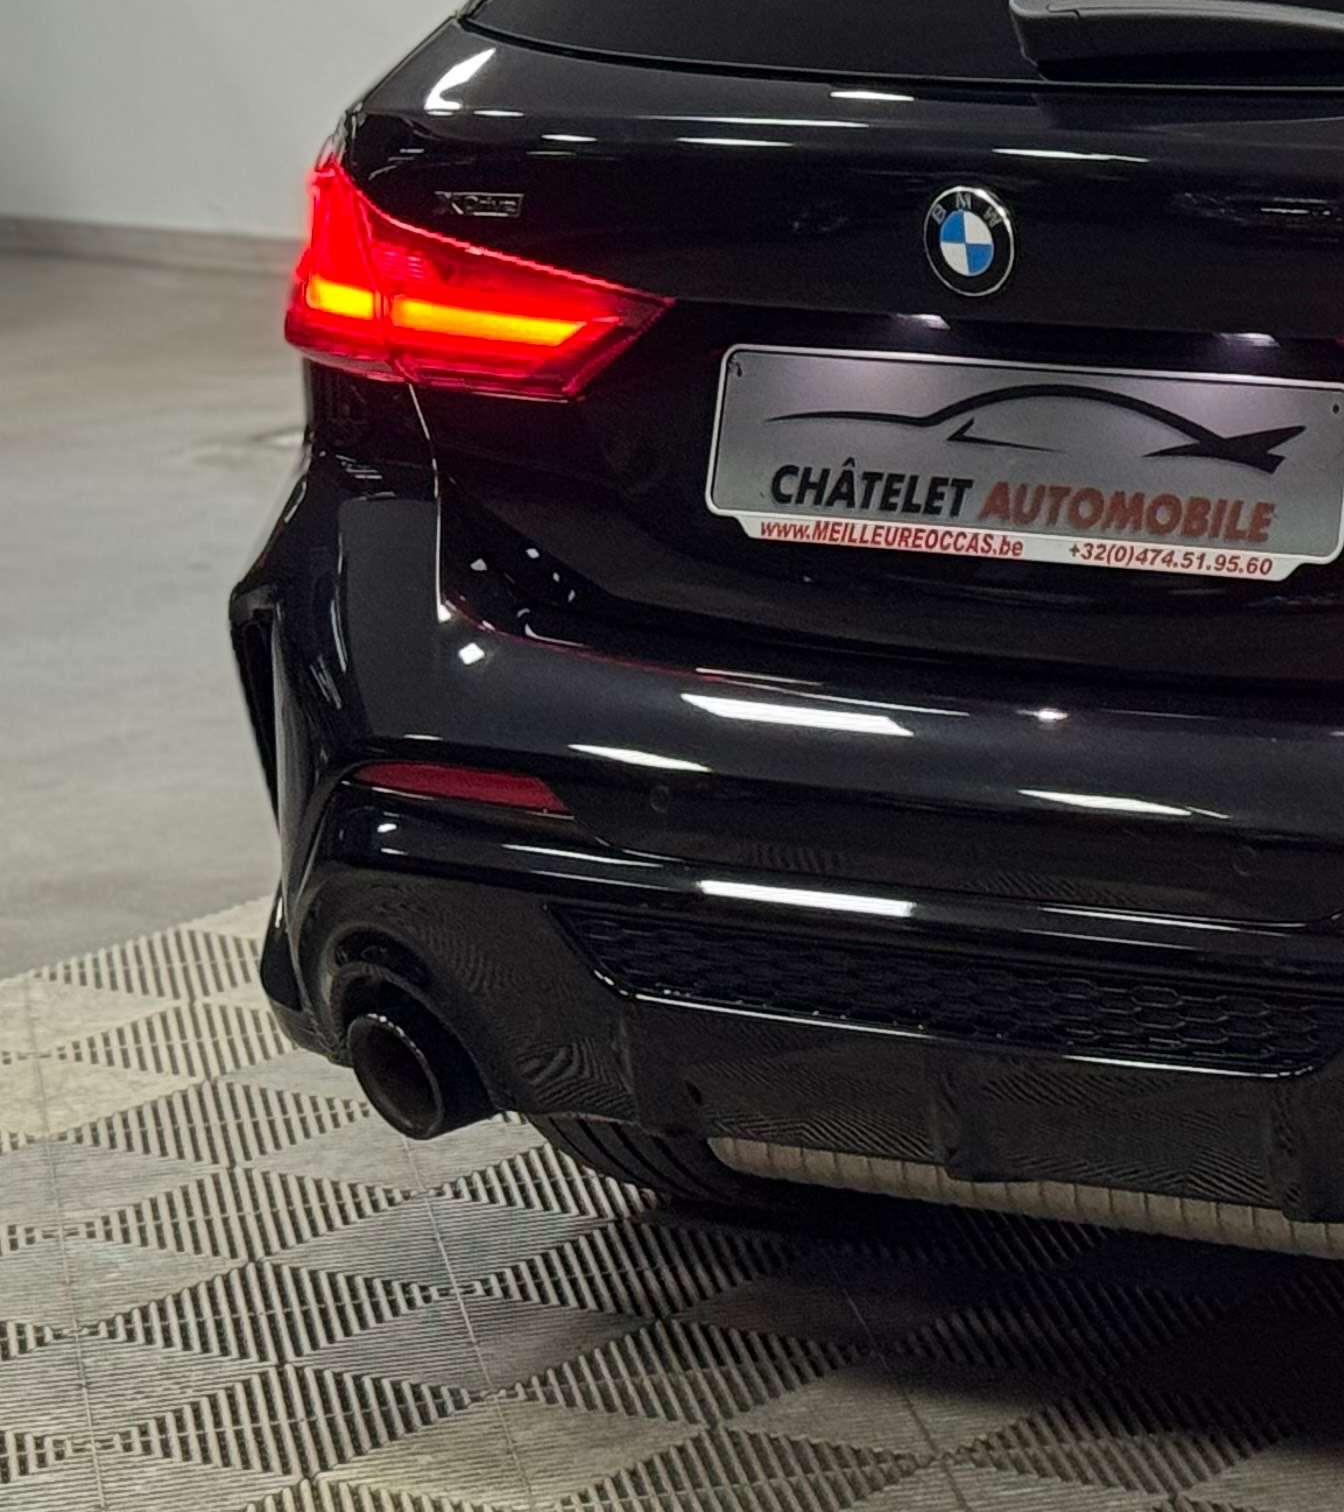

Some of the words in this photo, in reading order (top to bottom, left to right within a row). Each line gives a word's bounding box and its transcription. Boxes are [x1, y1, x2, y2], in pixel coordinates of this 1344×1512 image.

[931, 191, 1002, 229] BMW
[771, 456, 975, 519] CHÂTELET
[978, 480, 1277, 544] AUTOMOBILE
[760, 520, 1025, 557] www.MEILLEUREOCCAS.be
[1068, 542, 1274, 576] +32(0)474.51.95.60
